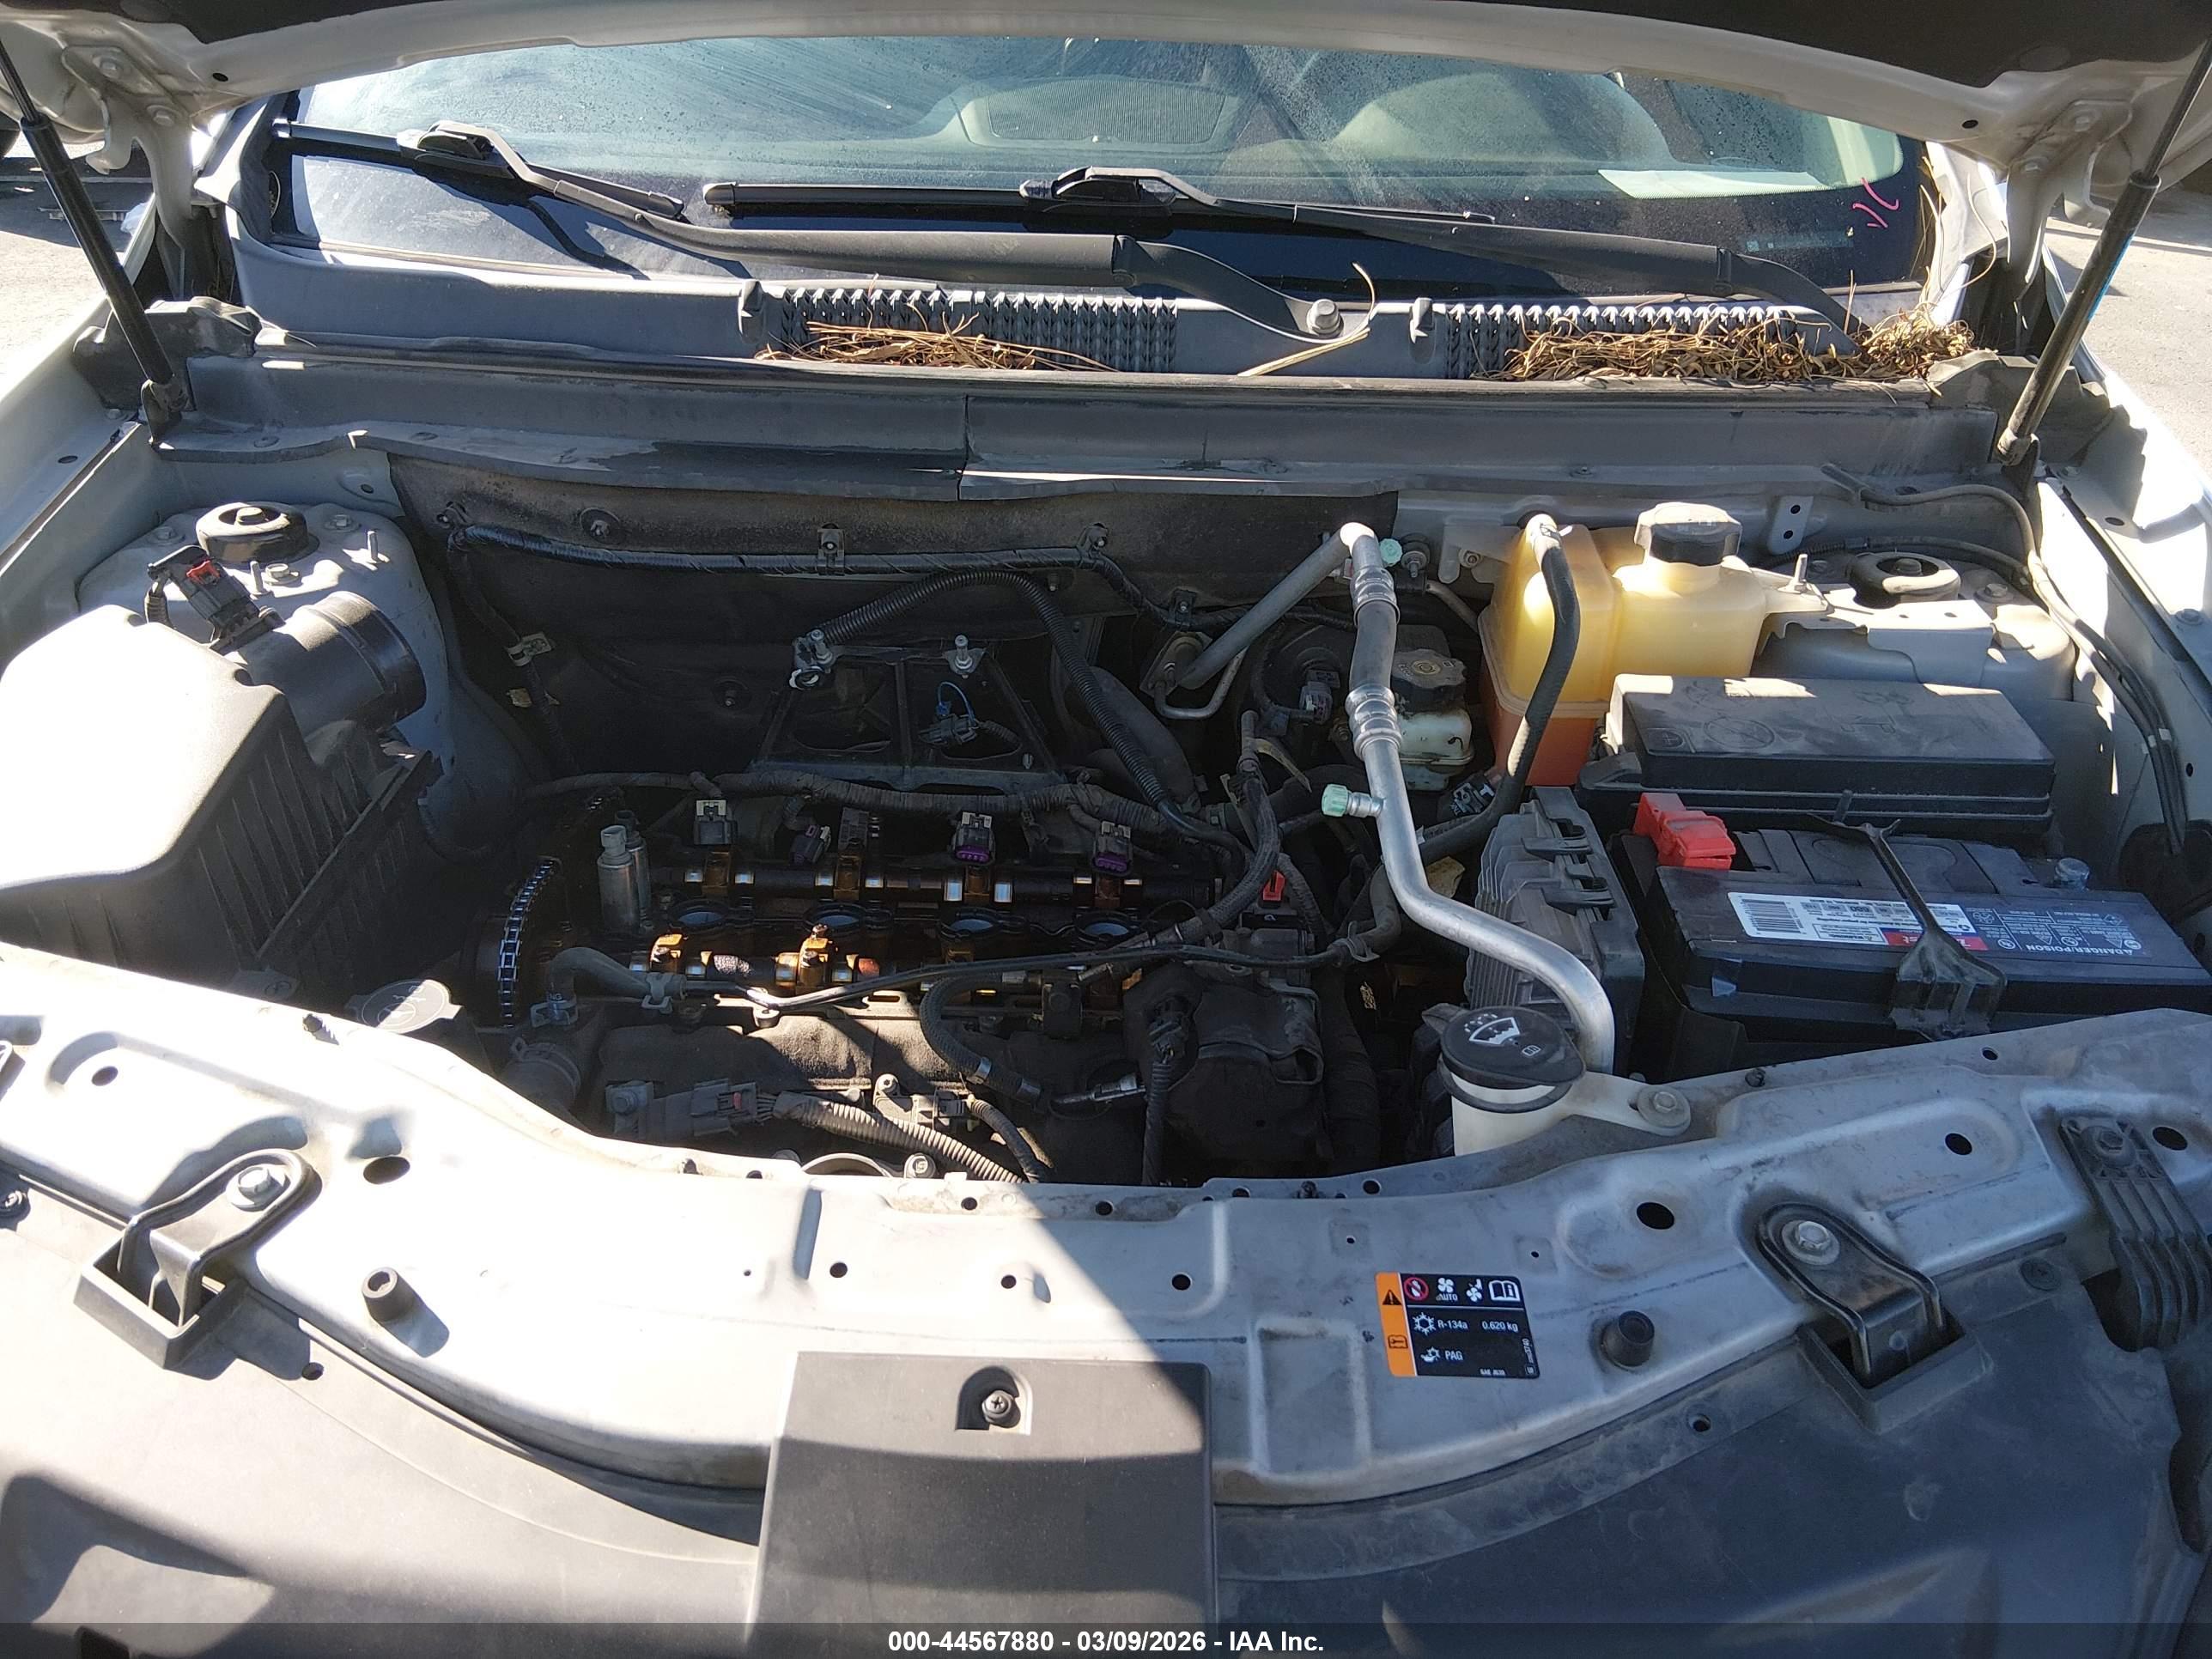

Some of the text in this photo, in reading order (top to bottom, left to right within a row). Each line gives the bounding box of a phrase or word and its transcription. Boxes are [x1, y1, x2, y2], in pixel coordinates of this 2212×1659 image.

[2026, 945, 2124, 954] DANGER/POISON
[1437, 1320, 1519, 1333] R-134a 0.620 kg
[1444, 1351, 1463, 1361] PAG
